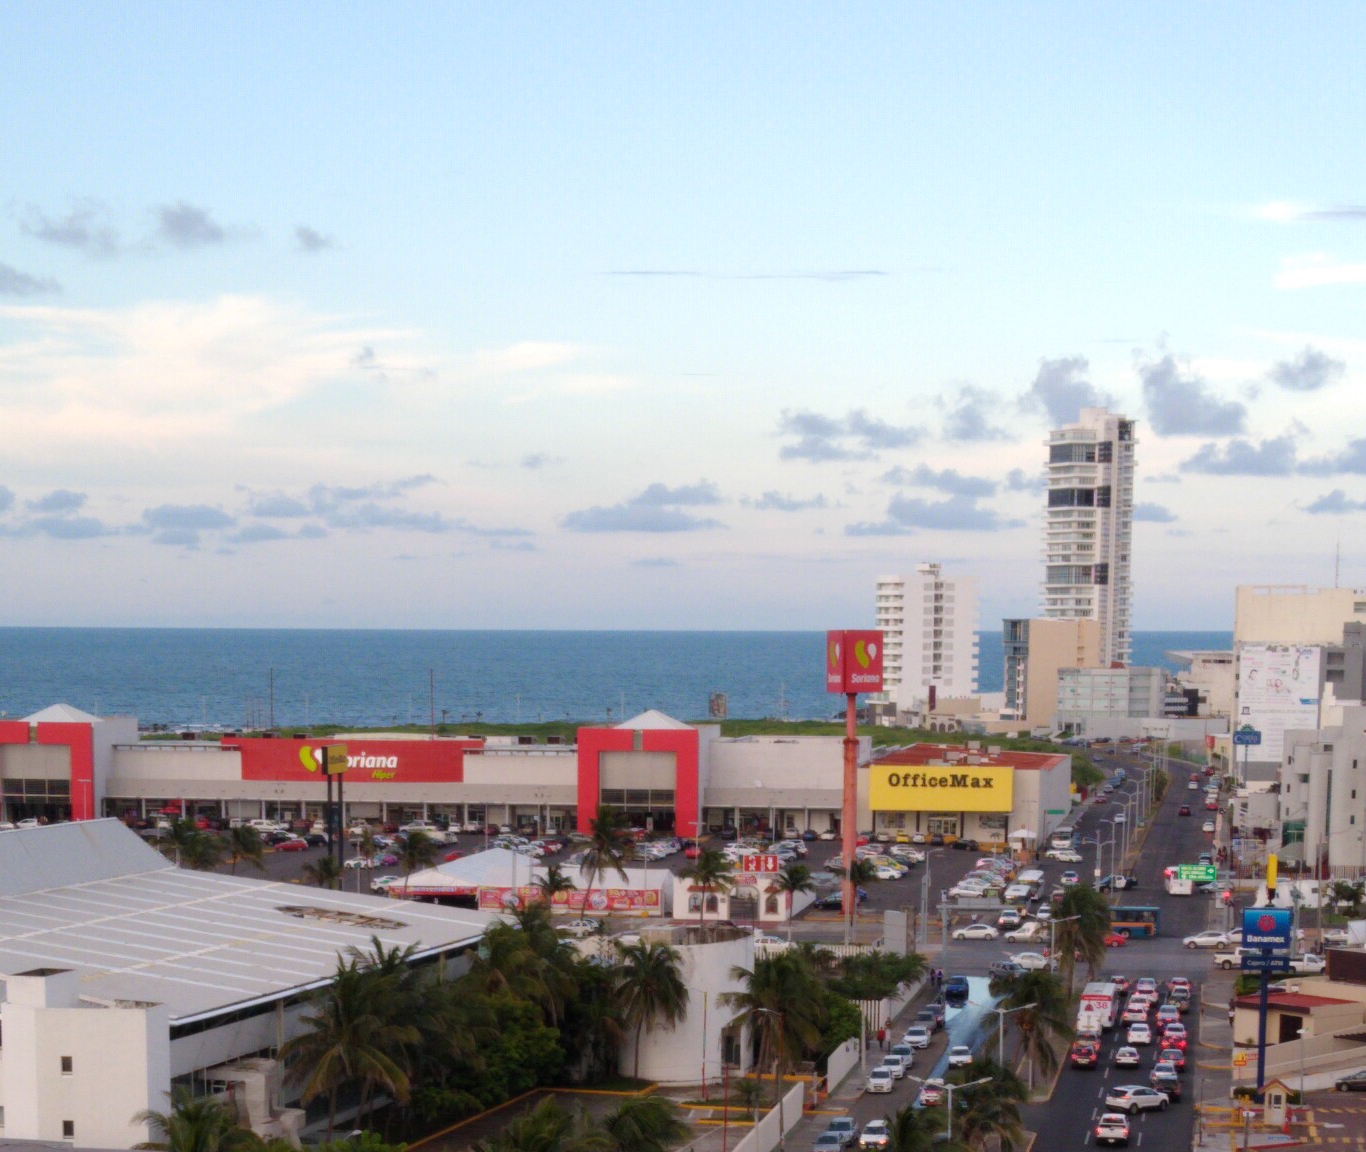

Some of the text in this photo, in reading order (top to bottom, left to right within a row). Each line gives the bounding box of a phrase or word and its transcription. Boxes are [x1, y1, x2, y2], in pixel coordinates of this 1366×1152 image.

[851, 673, 880, 684] Soriana
[347, 752, 398, 768] oriana
[888, 773, 994, 788] OfficeMax
[1246, 934, 1285, 943] Banamex
